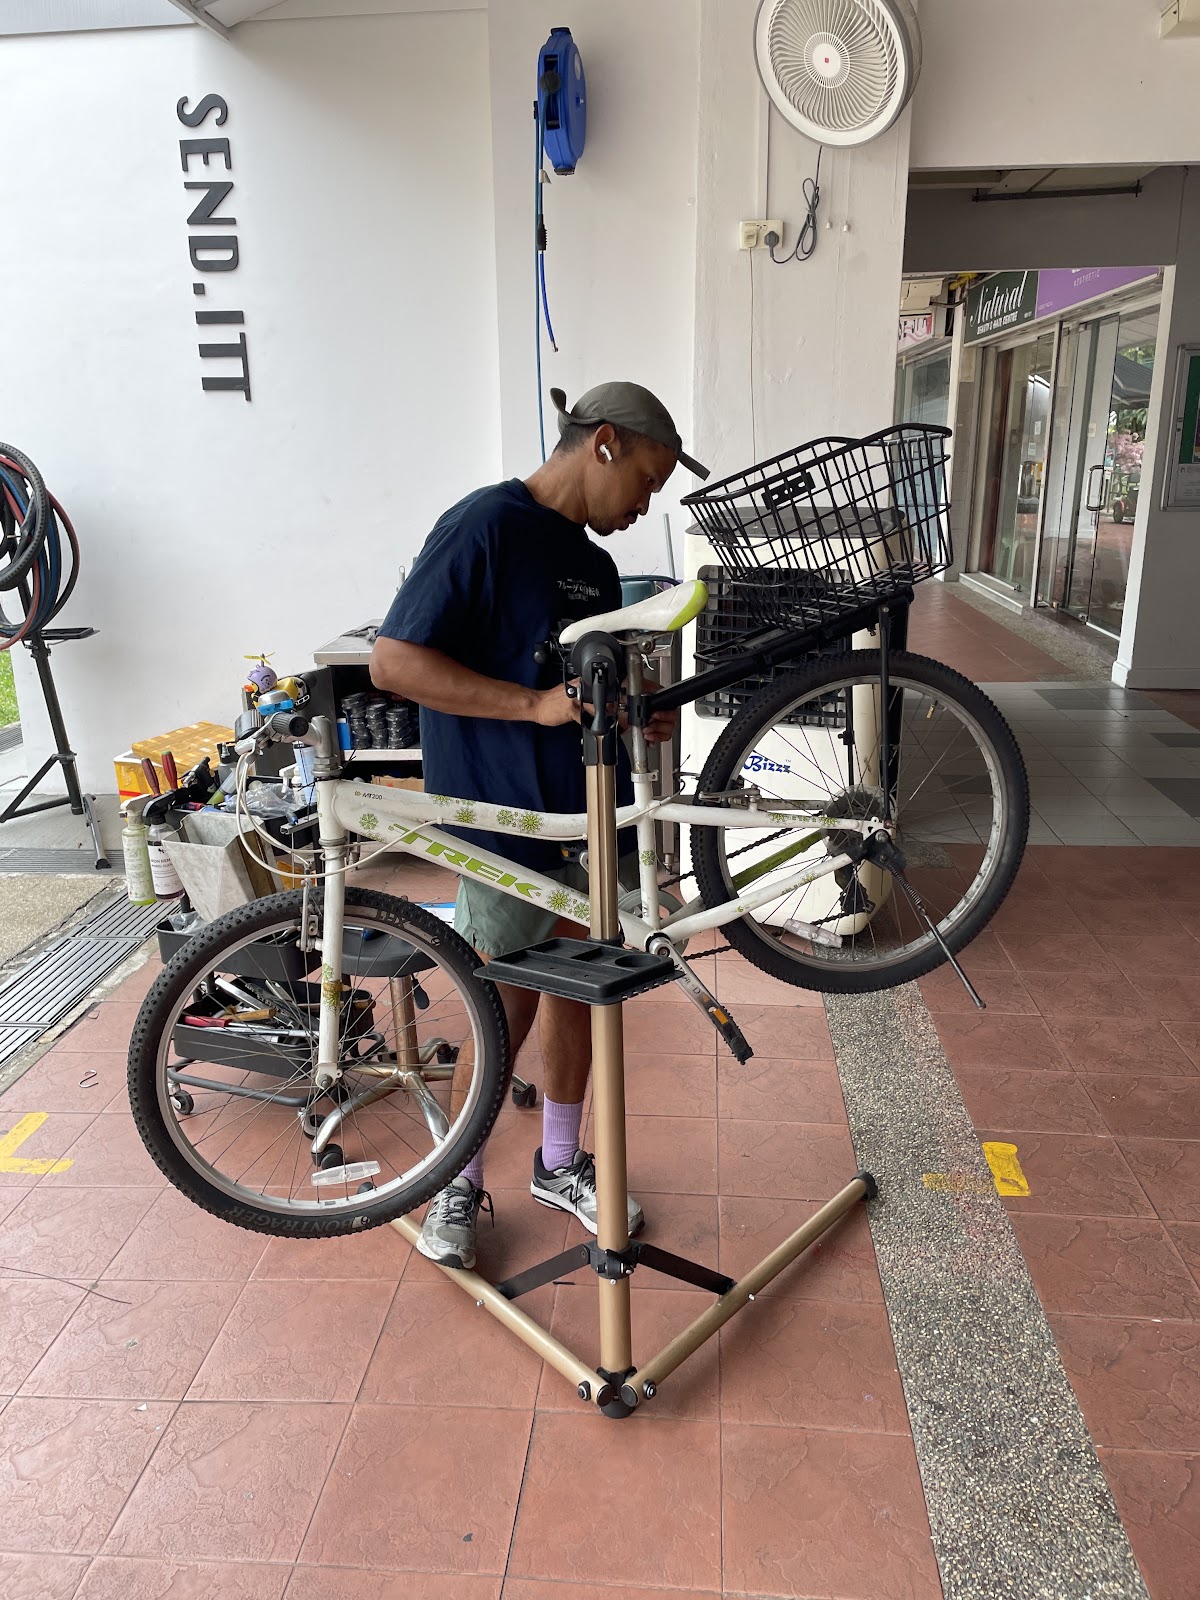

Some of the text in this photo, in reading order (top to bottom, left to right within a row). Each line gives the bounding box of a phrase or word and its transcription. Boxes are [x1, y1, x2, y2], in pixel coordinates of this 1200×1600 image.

[176, 93, 252, 402] SEND.ITT
[970, 270, 1029, 328] Natural
[743, 755, 791, 774] Bizzz
[392, 822, 543, 899] TREK
[228, 1205, 352, 1234] BONTRAGER
